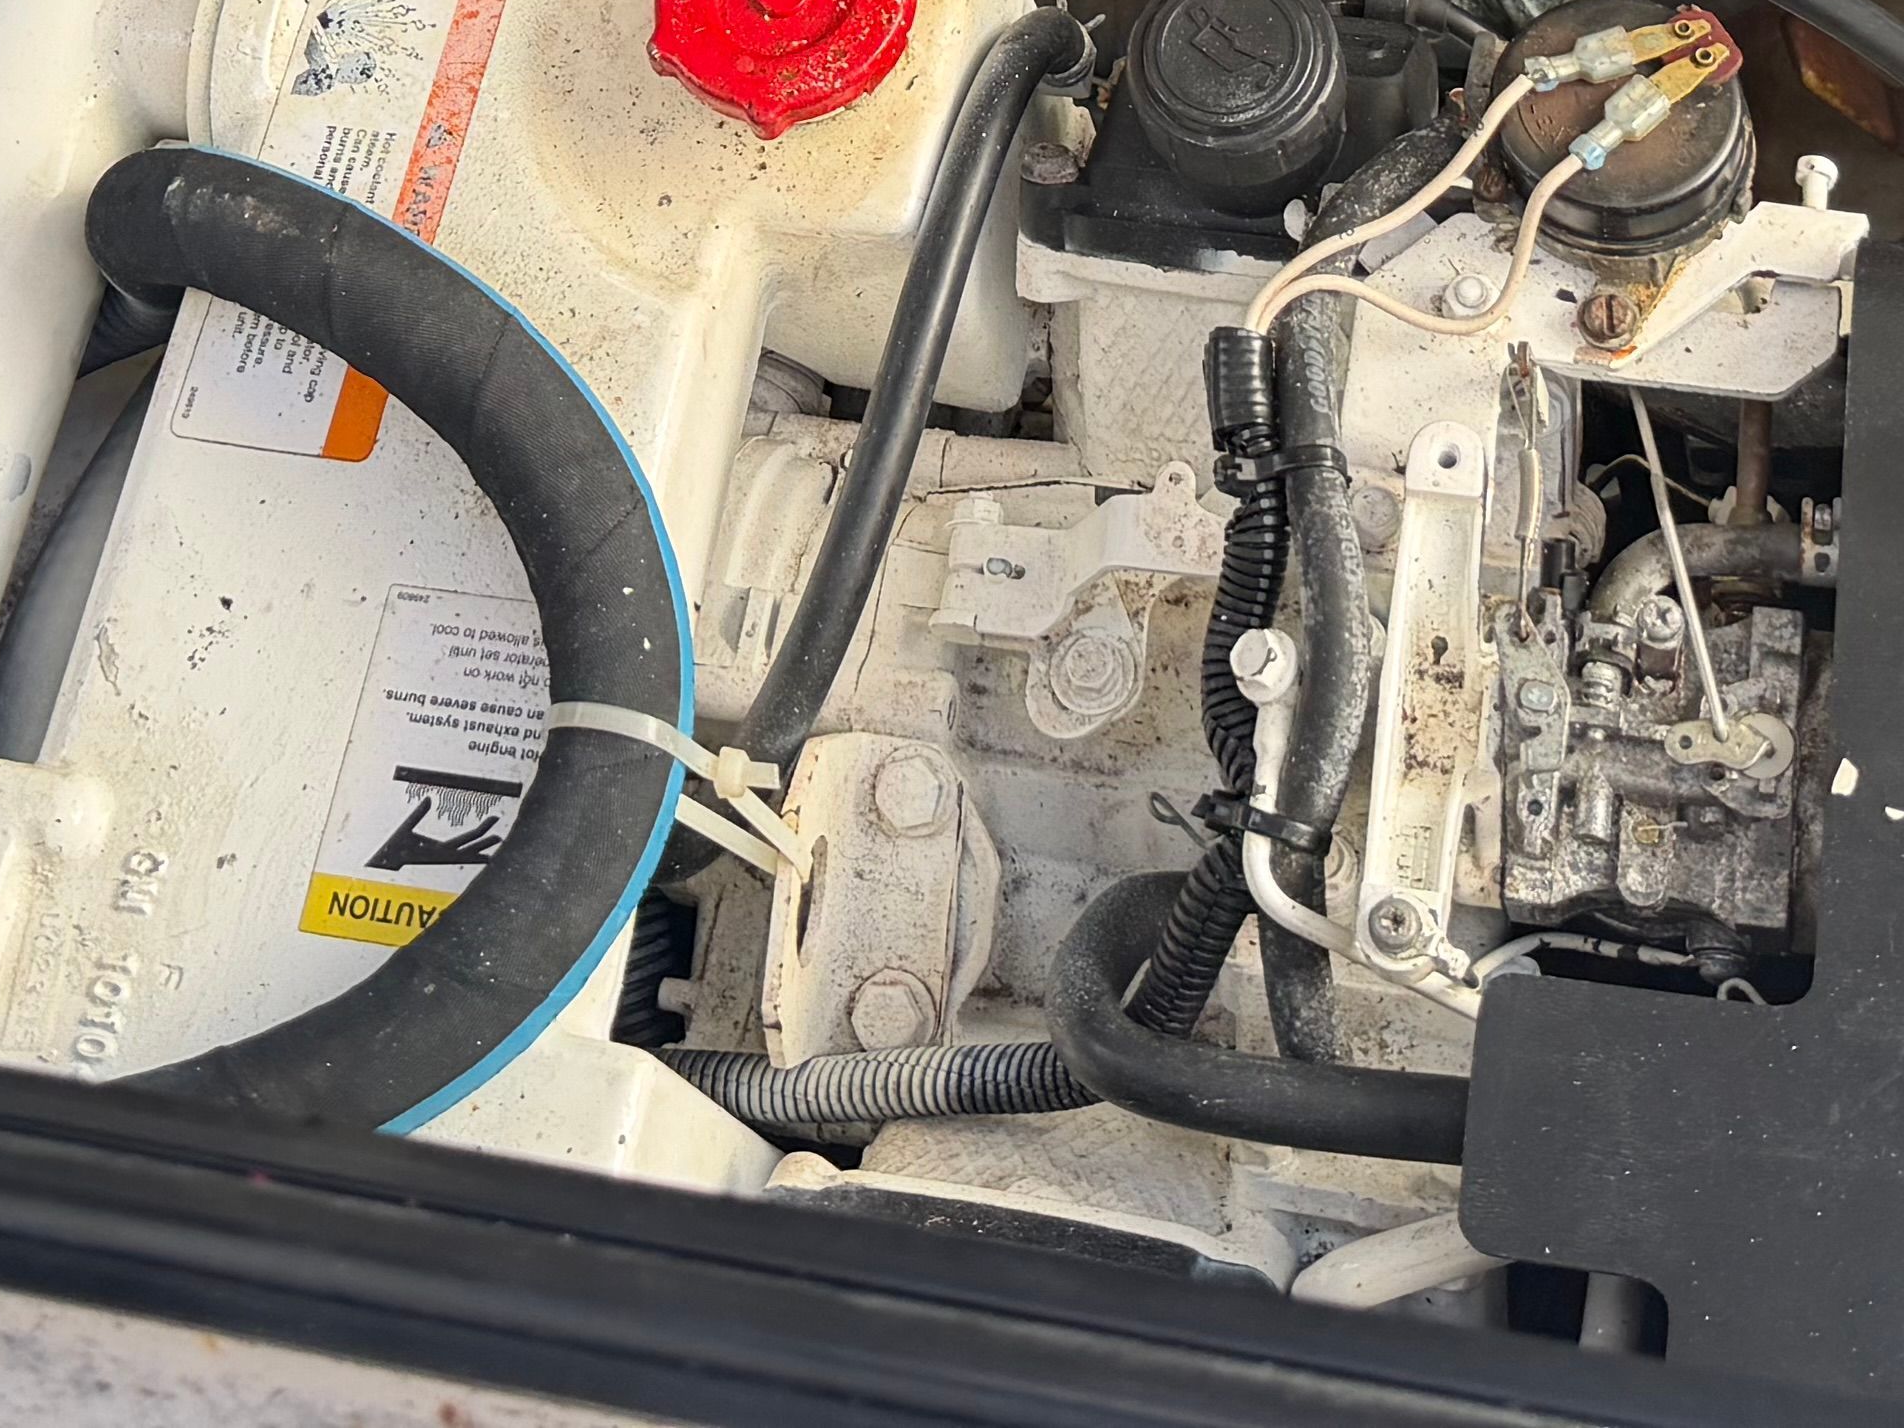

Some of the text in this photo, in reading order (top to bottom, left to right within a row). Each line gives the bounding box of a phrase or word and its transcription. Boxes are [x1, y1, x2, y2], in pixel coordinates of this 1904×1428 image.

[337, 126, 354, 164] burns
[350, 128, 368, 154] Can
[312, 125, 338, 180] personal
[365, 131, 398, 204] Hot coolant
[235, 332, 259, 374] before
[281, 349, 297, 375] and
[303, 378, 319, 404] cap
[463, 626, 477, 641] to
[478, 629, 531, 648] allowed
[447, 644, 478, 659] until
[479, 648, 500, 662] set
[463, 666, 481, 678] on
[483, 668, 516, 684] work
[518, 669, 540, 688] not
[382, 687, 428, 703] burns.
[429, 695, 478, 712] severe
[405, 710, 461, 729] system.
[479, 703, 524, 718] cause
[462, 720, 520, 739] exhaust
[467, 739, 518, 760] engine
[327, 890, 438, 929] AUTION
